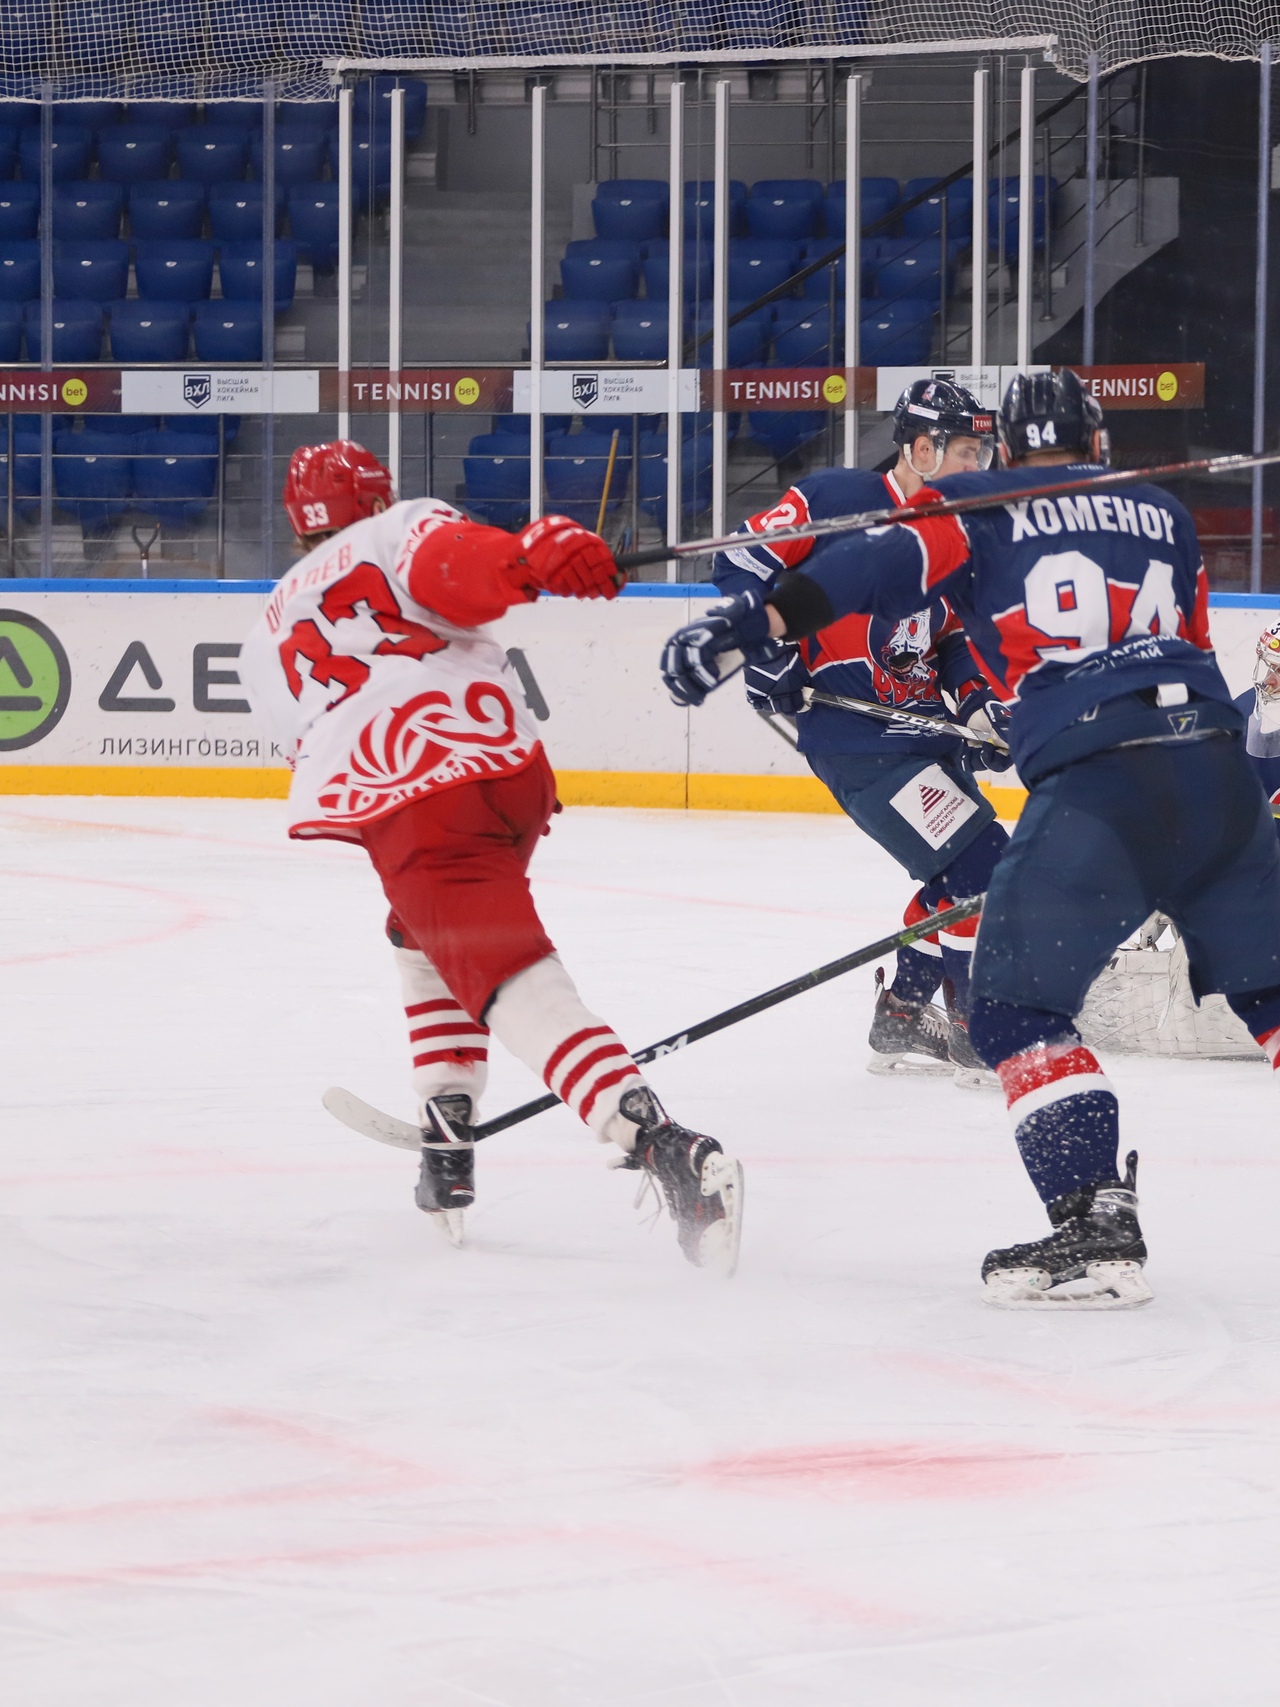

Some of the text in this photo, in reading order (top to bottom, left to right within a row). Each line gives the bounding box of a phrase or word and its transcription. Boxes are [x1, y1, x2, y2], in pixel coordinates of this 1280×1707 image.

[65, 385, 84, 397] bet
[185, 381, 210, 398] ВХЛ
[217, 385, 259, 393] ХОККЕЙНАЯ
[353, 382, 476, 401] TENNISI bet
[573, 381, 597, 398] ВХЛ
[730, 381, 844, 401] TENNISI bet
[1159, 379, 1175, 392] bet
[1025, 420, 1057, 449] 94
[302, 501, 330, 528] 33
[1023, 549, 1180, 664] 94
[280, 561, 450, 712] 33
[890, 711, 945, 731] CCM
[100, 738, 259, 758] лизинговая
[933, 816, 956, 839] КОМБИНАТ
